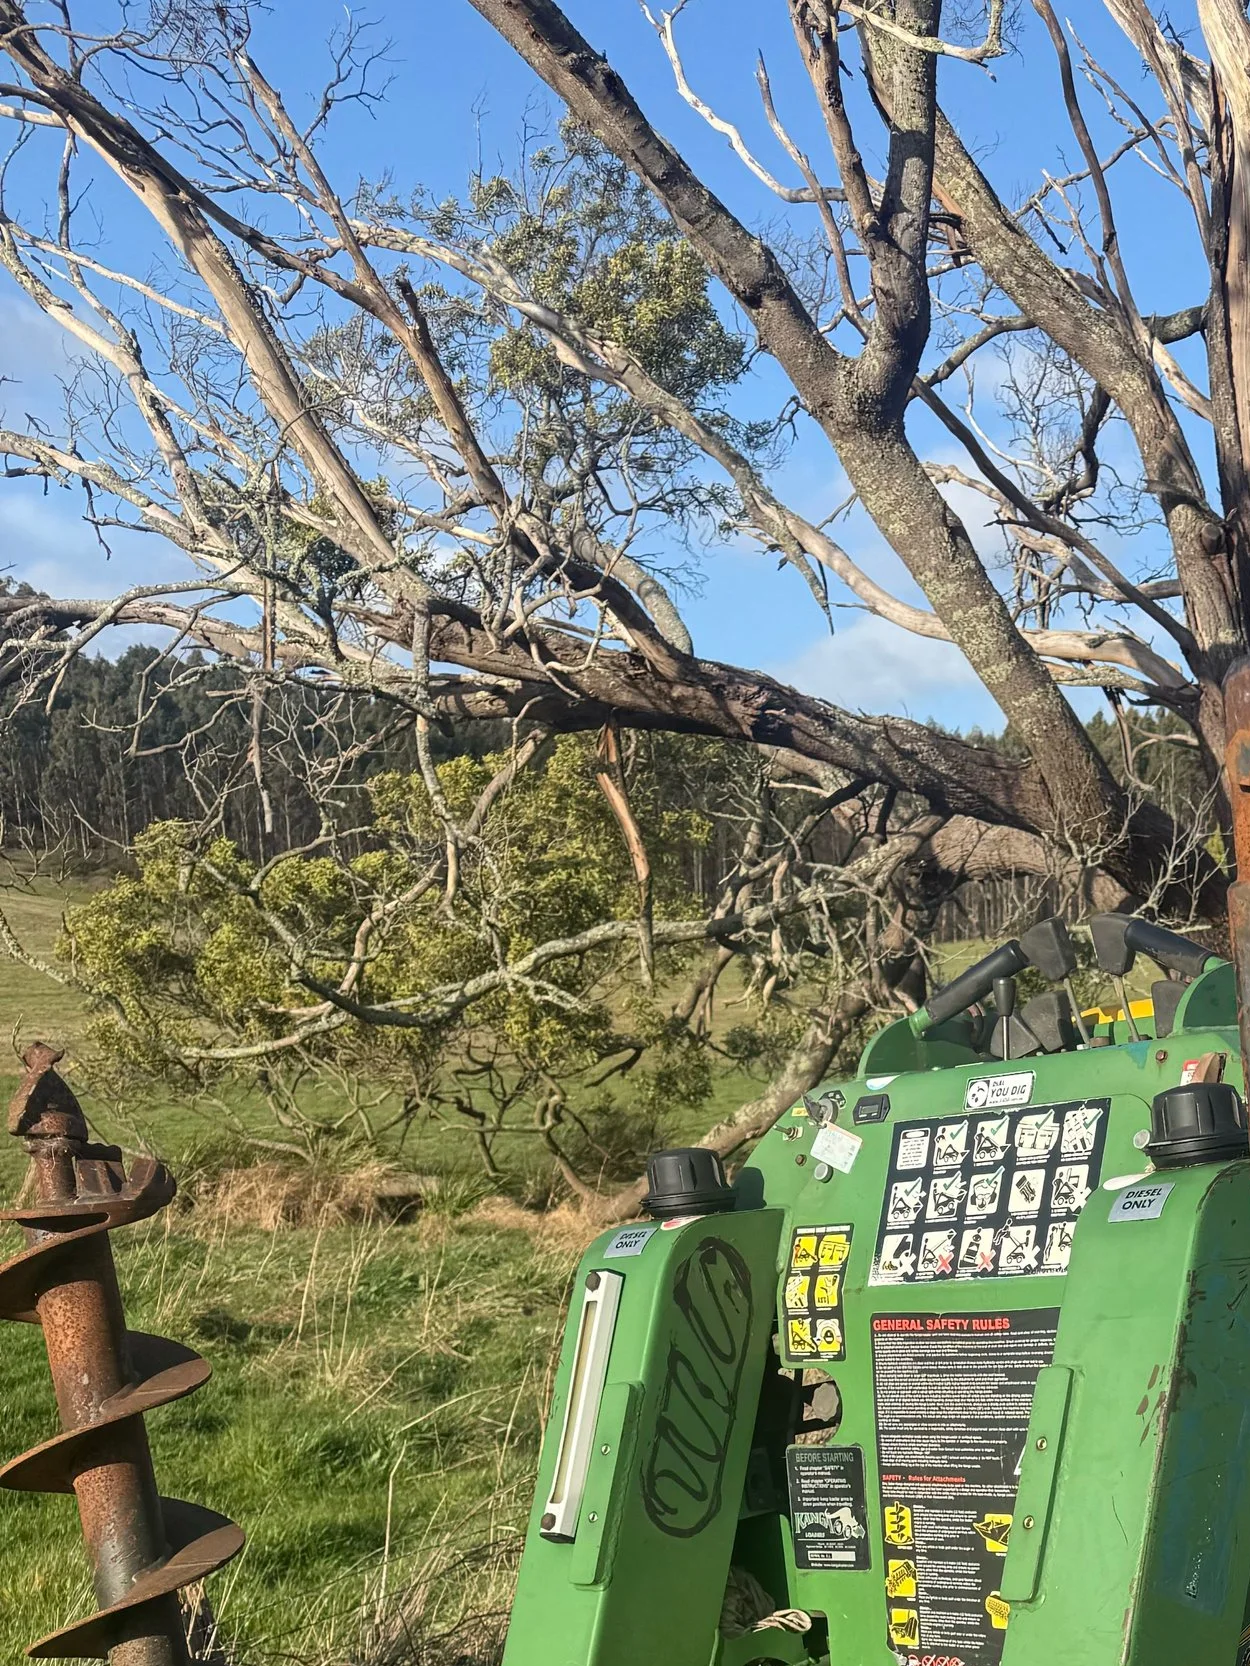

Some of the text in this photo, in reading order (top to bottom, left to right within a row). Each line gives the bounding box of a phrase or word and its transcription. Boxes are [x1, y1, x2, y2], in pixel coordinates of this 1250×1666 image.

[990, 1084, 1027, 1098] YOU DIG
[1125, 1187, 1163, 1199] DIESEL
[1122, 1198, 1155, 1210] ONLY
[615, 1239, 641, 1249] ONLY
[873, 1317, 1011, 1331] GENERAL SAFETY RULES
[795, 1452, 854, 1462] BEFORE STARTING
[794, 1511, 836, 1534] KANGA
